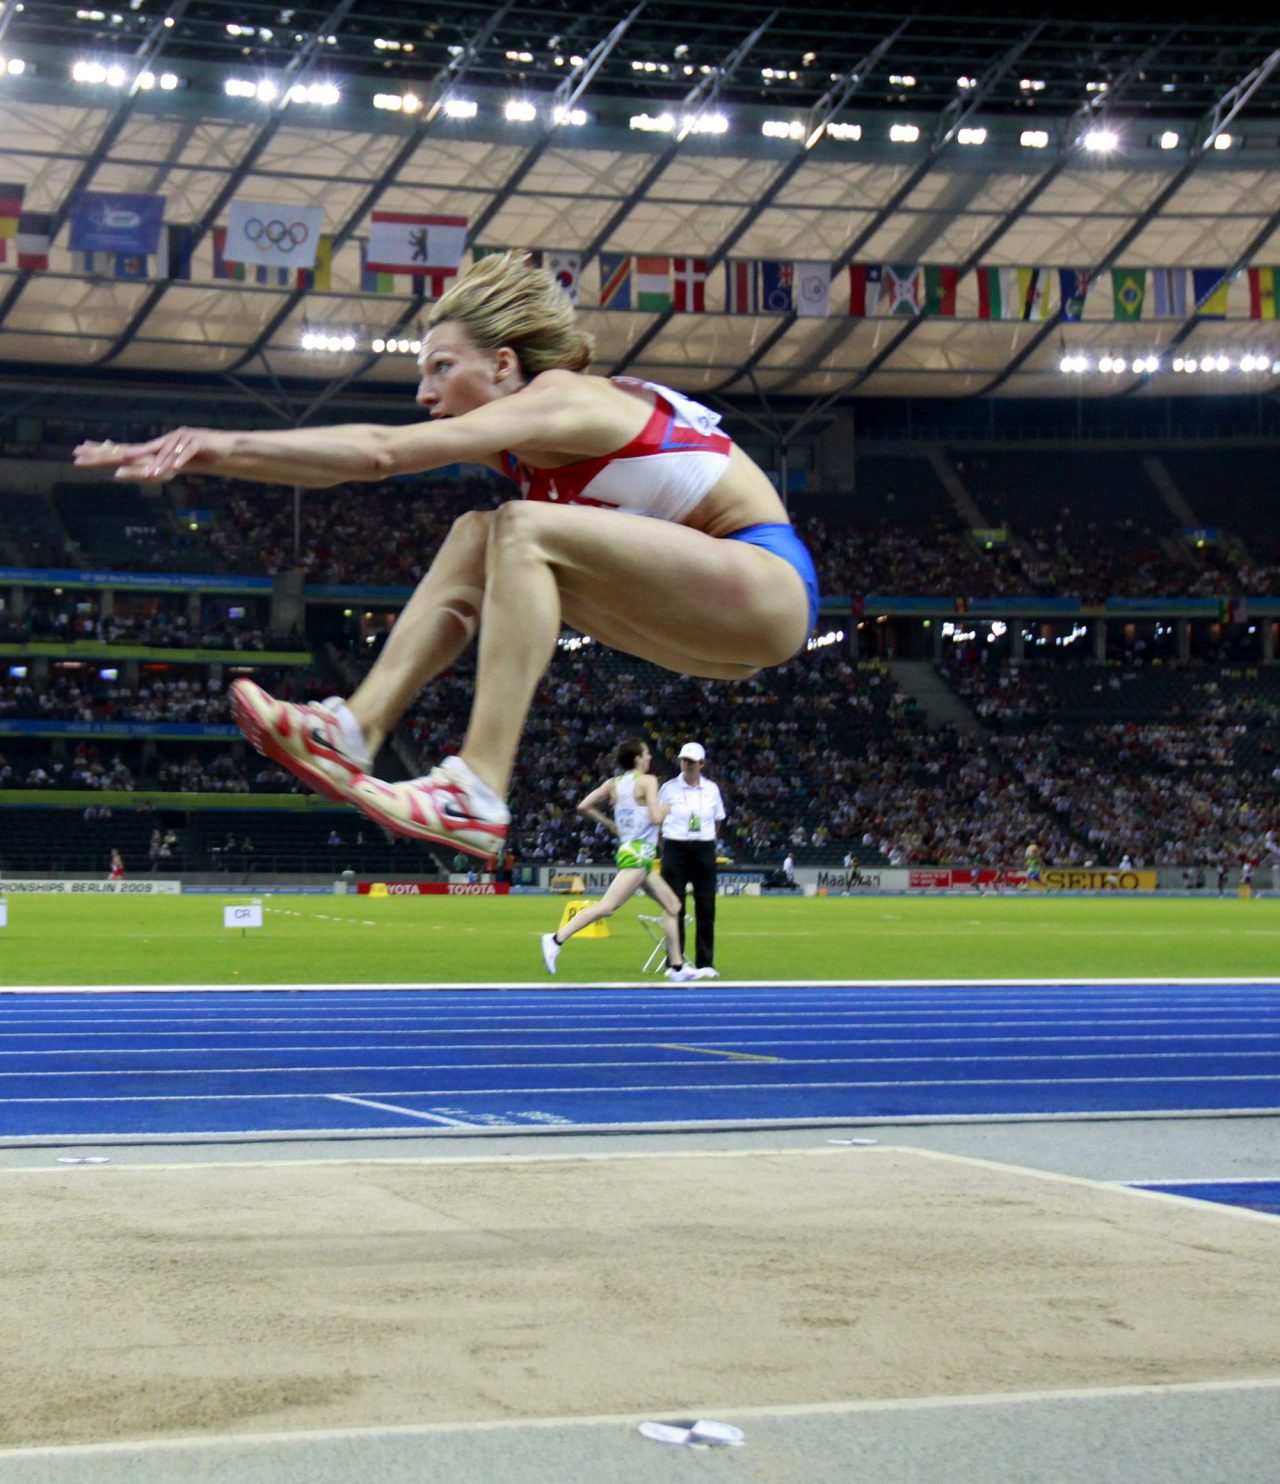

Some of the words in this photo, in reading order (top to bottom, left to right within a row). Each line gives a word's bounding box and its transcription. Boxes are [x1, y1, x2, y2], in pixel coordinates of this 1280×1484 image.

[71, 883, 116, 892] BERLIN
[121, 883, 152, 892] 2009
[388, 885, 419, 894] YOTA
[448, 885, 495, 894] TOYOTA
